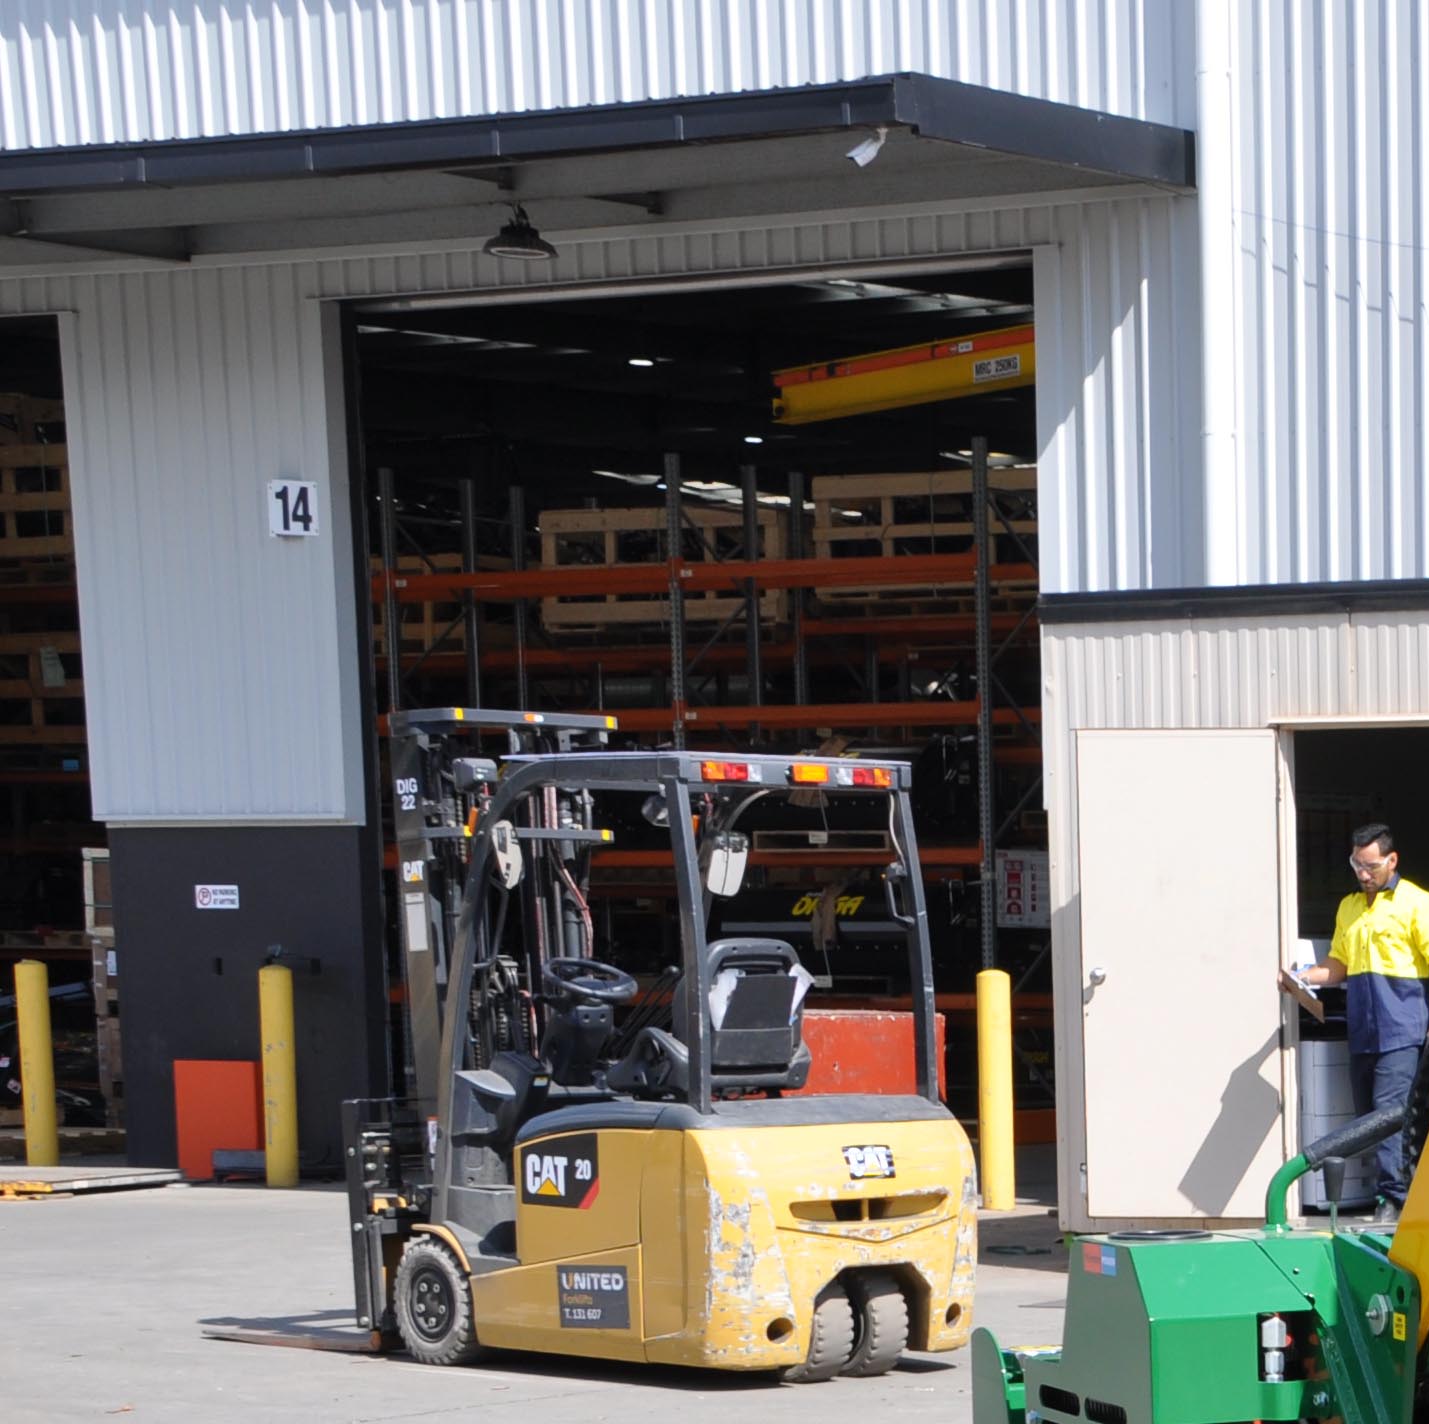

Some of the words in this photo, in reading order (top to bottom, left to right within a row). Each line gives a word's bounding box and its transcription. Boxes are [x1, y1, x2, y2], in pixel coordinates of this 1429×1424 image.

[275, 485, 312, 531] 14
[396, 777, 418, 794] DIG
[401, 795, 416, 810] 22
[403, 860, 424, 881] CAT
[848, 1146, 893, 1178] CAT
[526, 1153, 568, 1196] CAT
[574, 1159, 592, 1181] 20
[561, 1272, 624, 1291] UNITED
